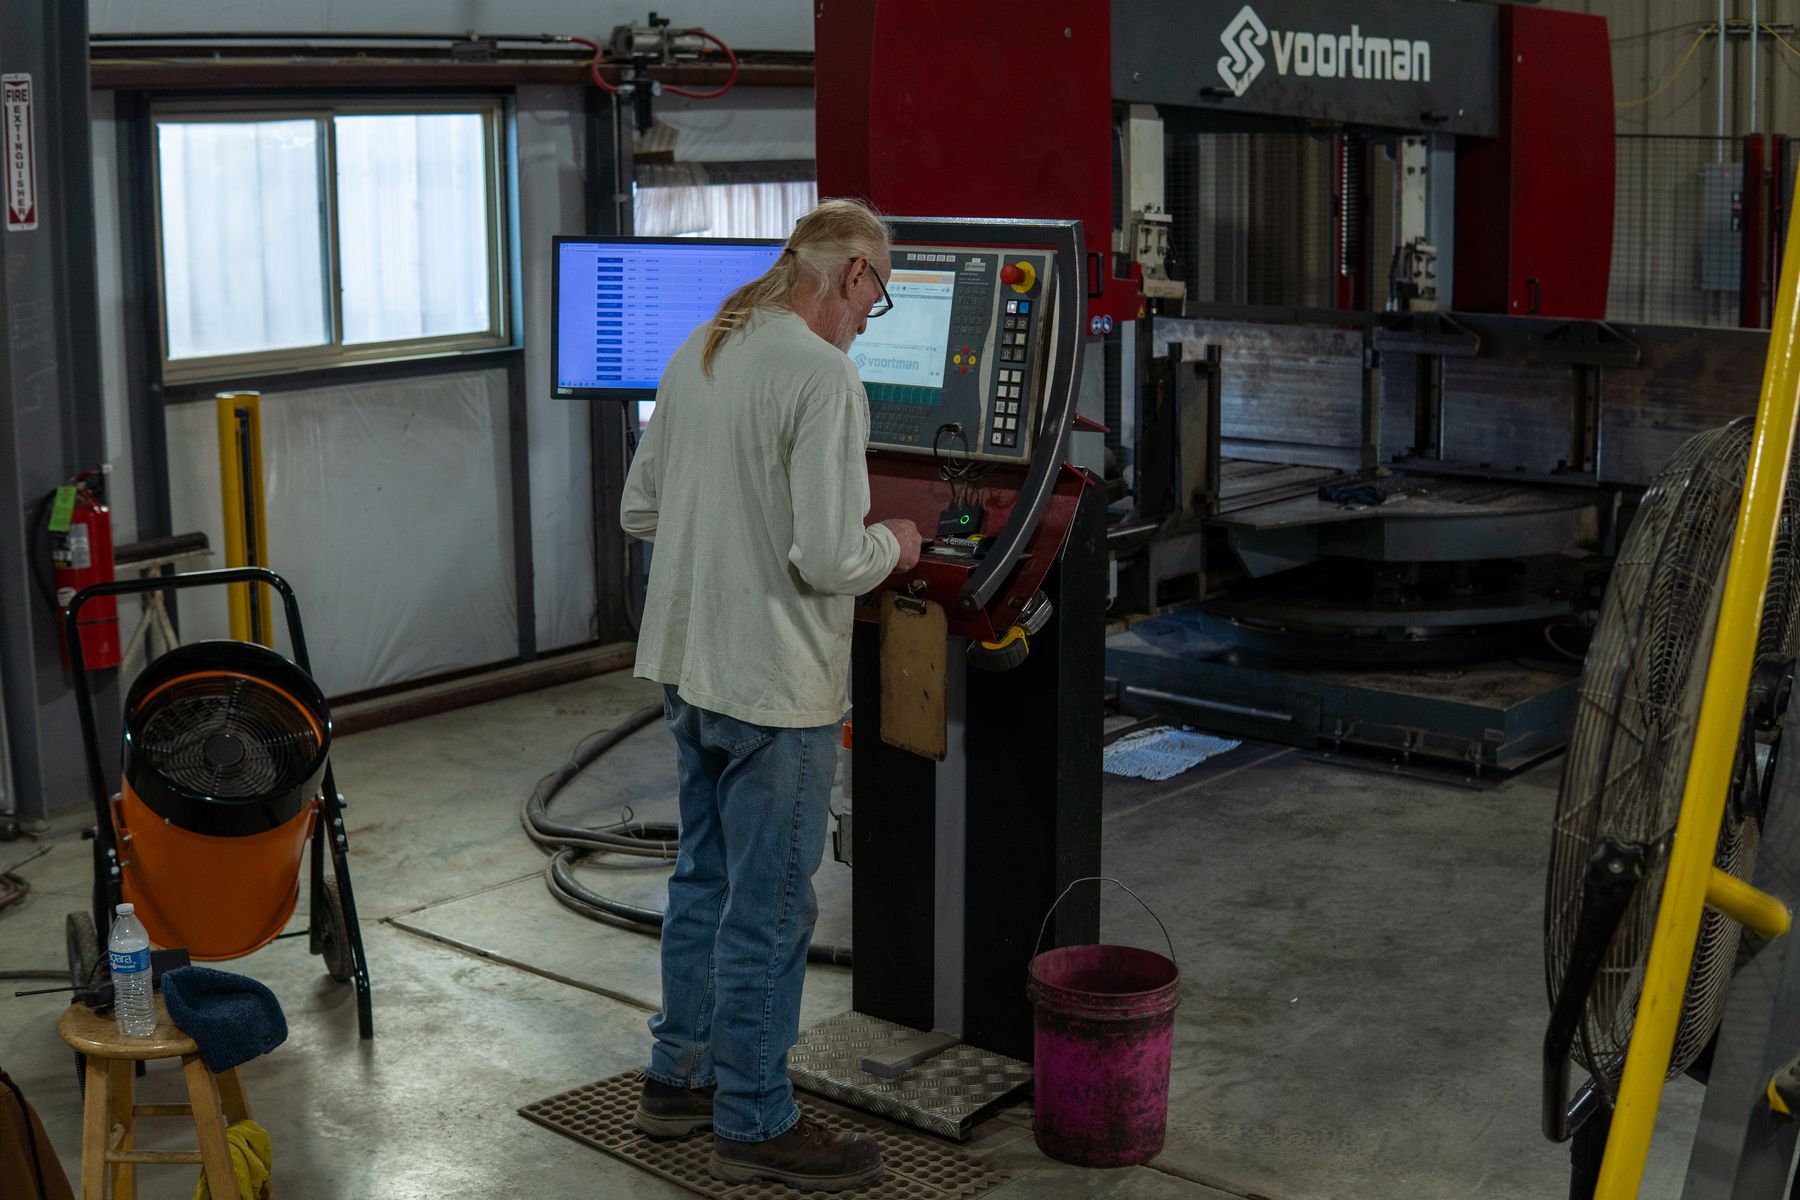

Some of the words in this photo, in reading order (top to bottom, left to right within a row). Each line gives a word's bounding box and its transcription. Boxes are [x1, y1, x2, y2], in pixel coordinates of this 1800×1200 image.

[1270, 24, 1431, 82] voortman
[6, 89, 28, 102] FIRE
[13, 105, 26, 216] EXTINGUISHER
[868, 356, 919, 370] voortman
